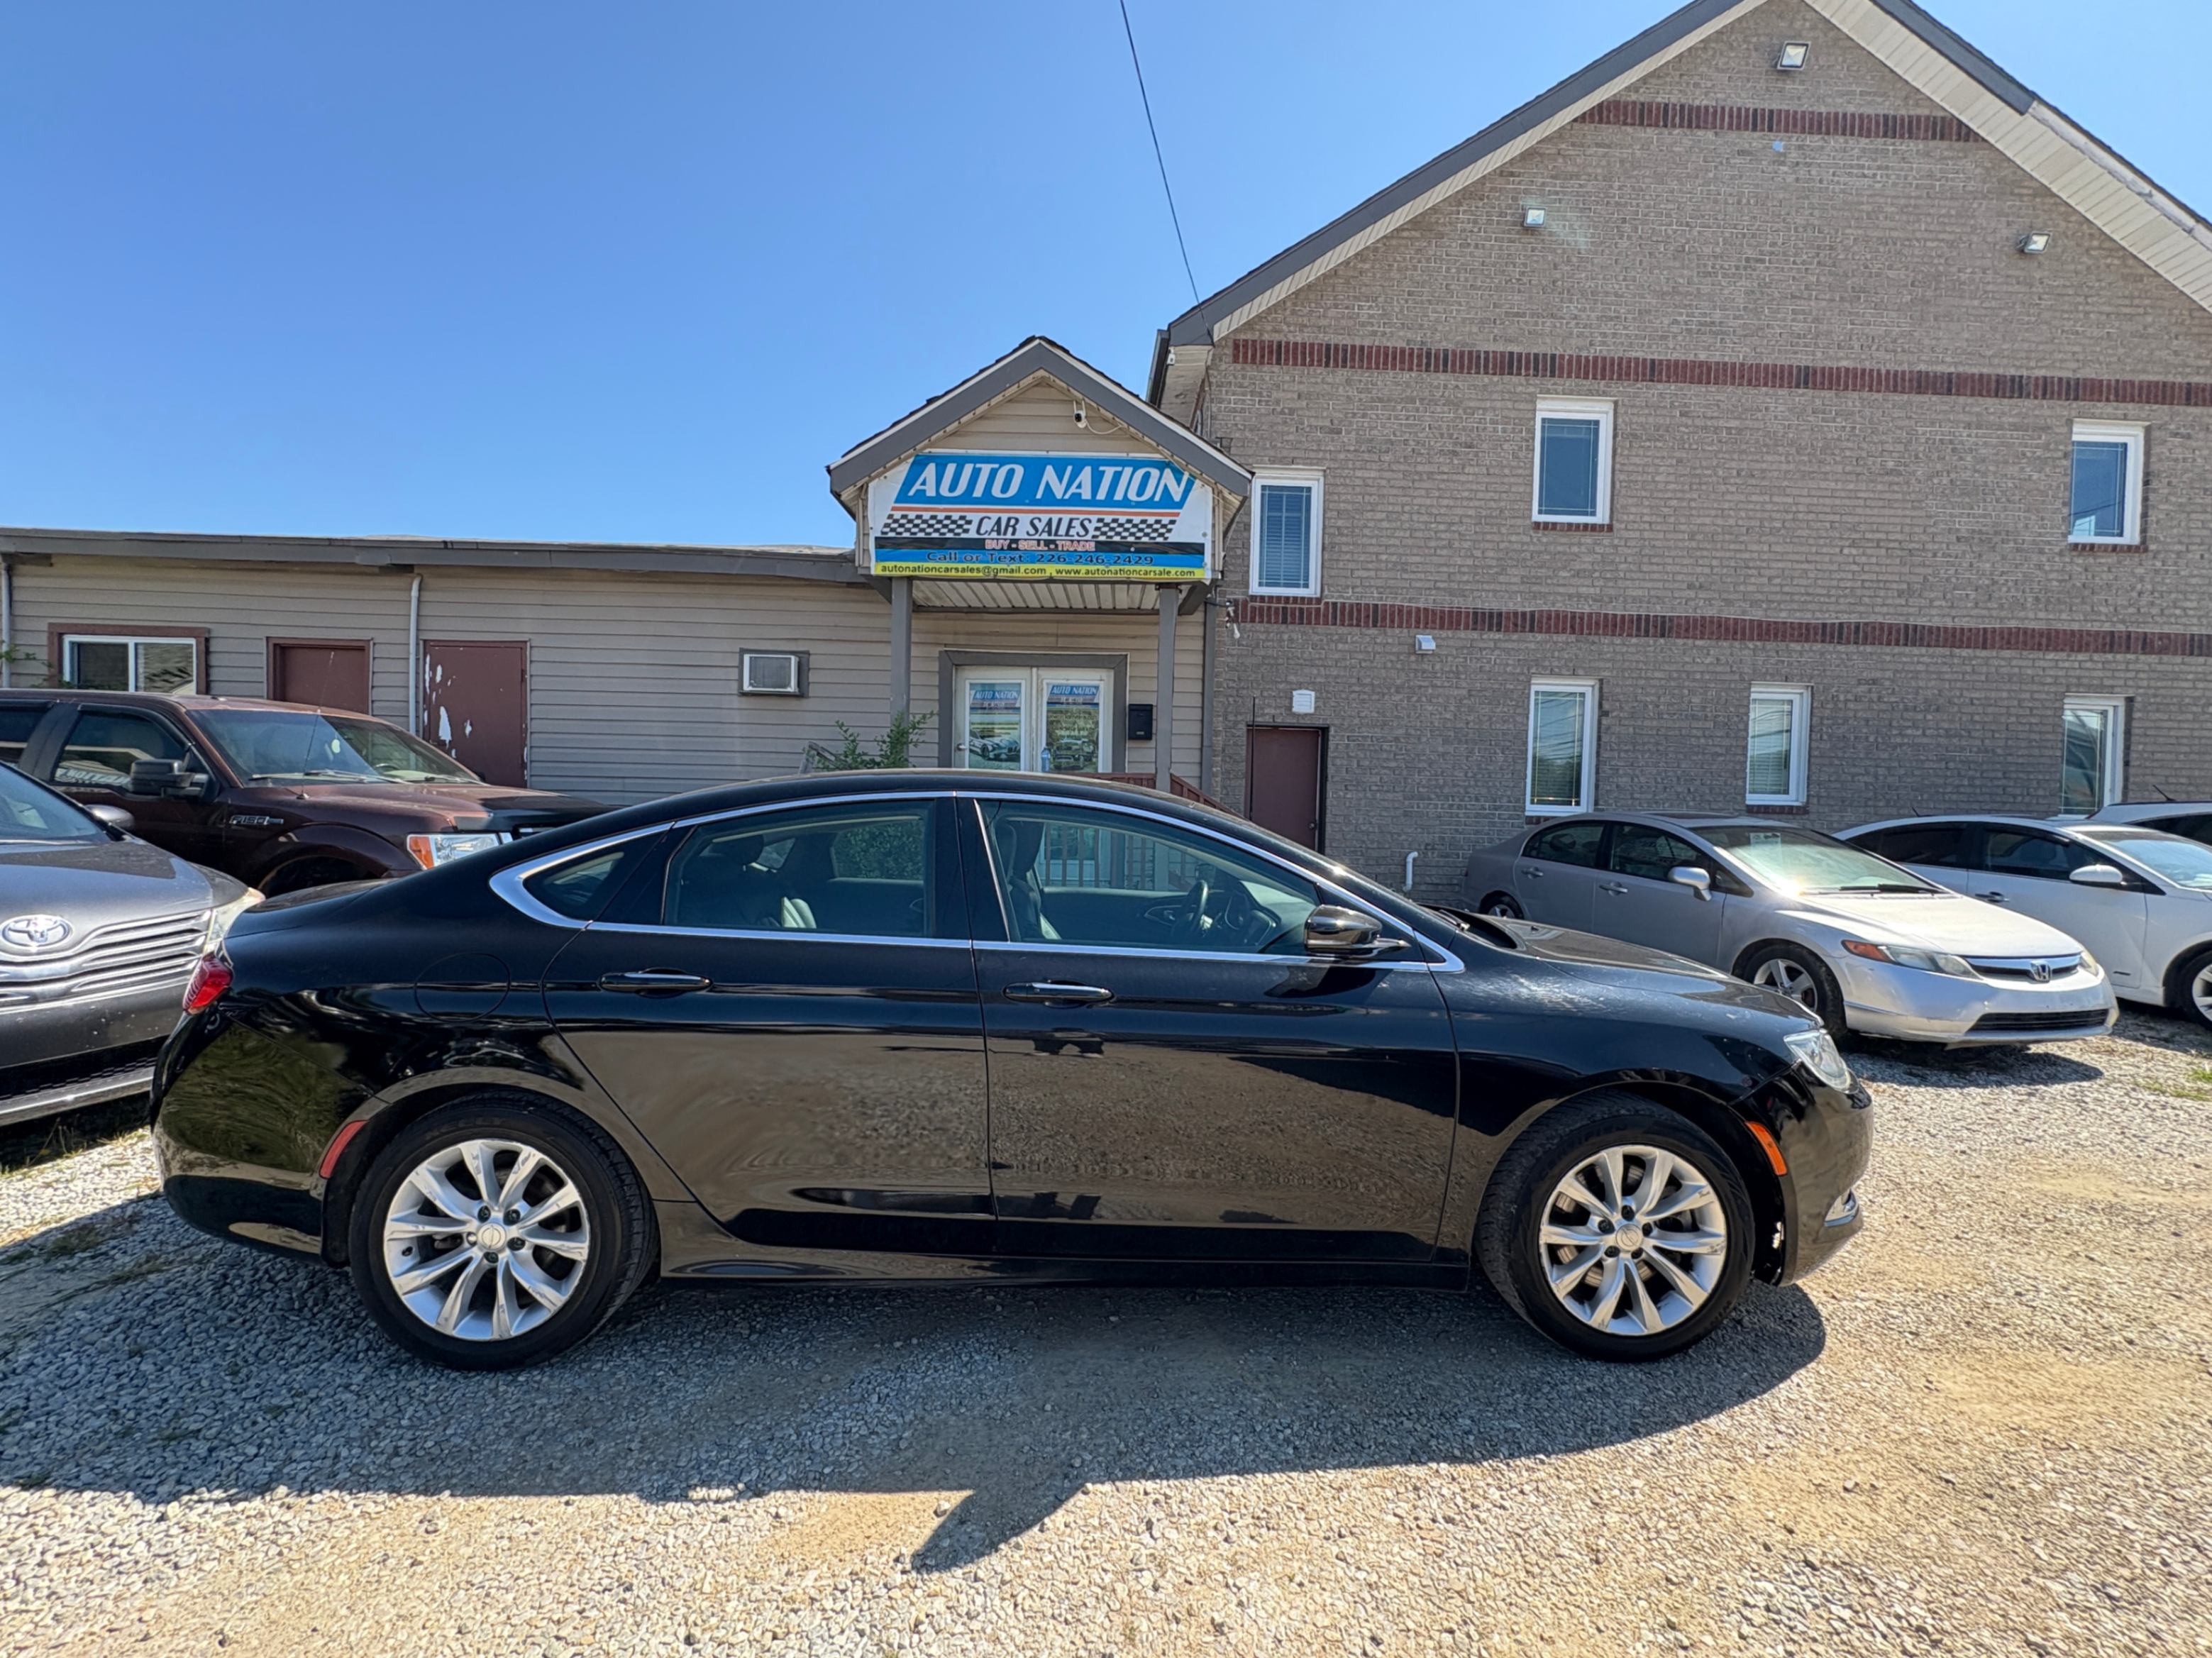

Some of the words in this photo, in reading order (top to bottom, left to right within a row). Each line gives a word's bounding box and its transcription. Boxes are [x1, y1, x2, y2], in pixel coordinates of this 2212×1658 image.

[907, 462, 1025, 498] AUTO
[1035, 465, 1190, 502] NATION
[975, 515, 1020, 536] CAR
[1026, 516, 1093, 538] SALES
[985, 539, 1010, 550] BUY
[1018, 540, 1048, 551] SELL
[1056, 541, 1095, 551] TRADE
[927, 551, 957, 561] Call
[963, 553, 981, 562] or
[988, 553, 1029, 563] Text:
[1036, 553, 1154, 565] 226-246-2429
[881, 564, 1046, 577] autonationcarsales@gmail.com
[1055, 566, 1195, 577] www.autonationcarsale.com
